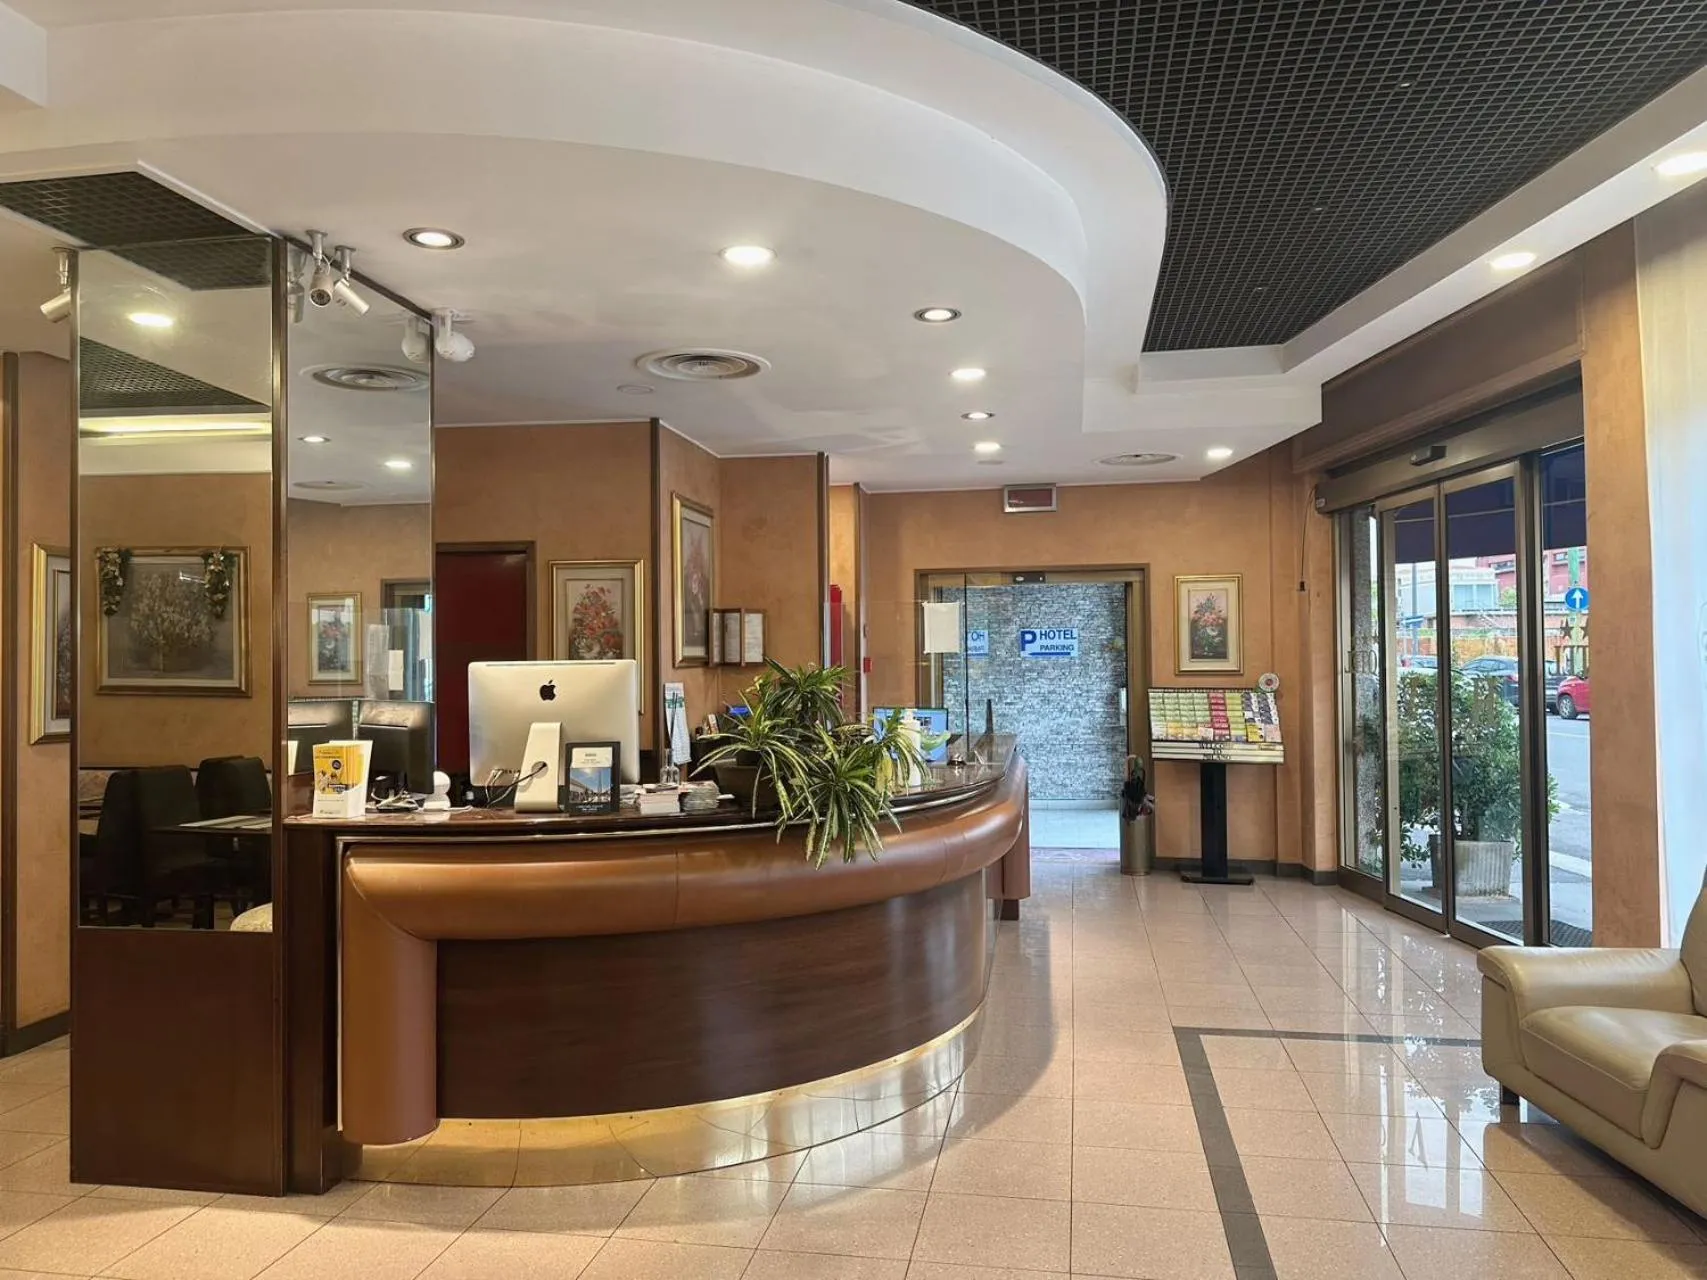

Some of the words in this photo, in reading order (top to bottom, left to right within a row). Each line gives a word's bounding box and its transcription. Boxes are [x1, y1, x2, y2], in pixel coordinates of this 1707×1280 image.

[1039, 629, 1077, 640] HOTEL
[1021, 630, 1037, 652] P
[1040, 644, 1075, 652] PARKING
